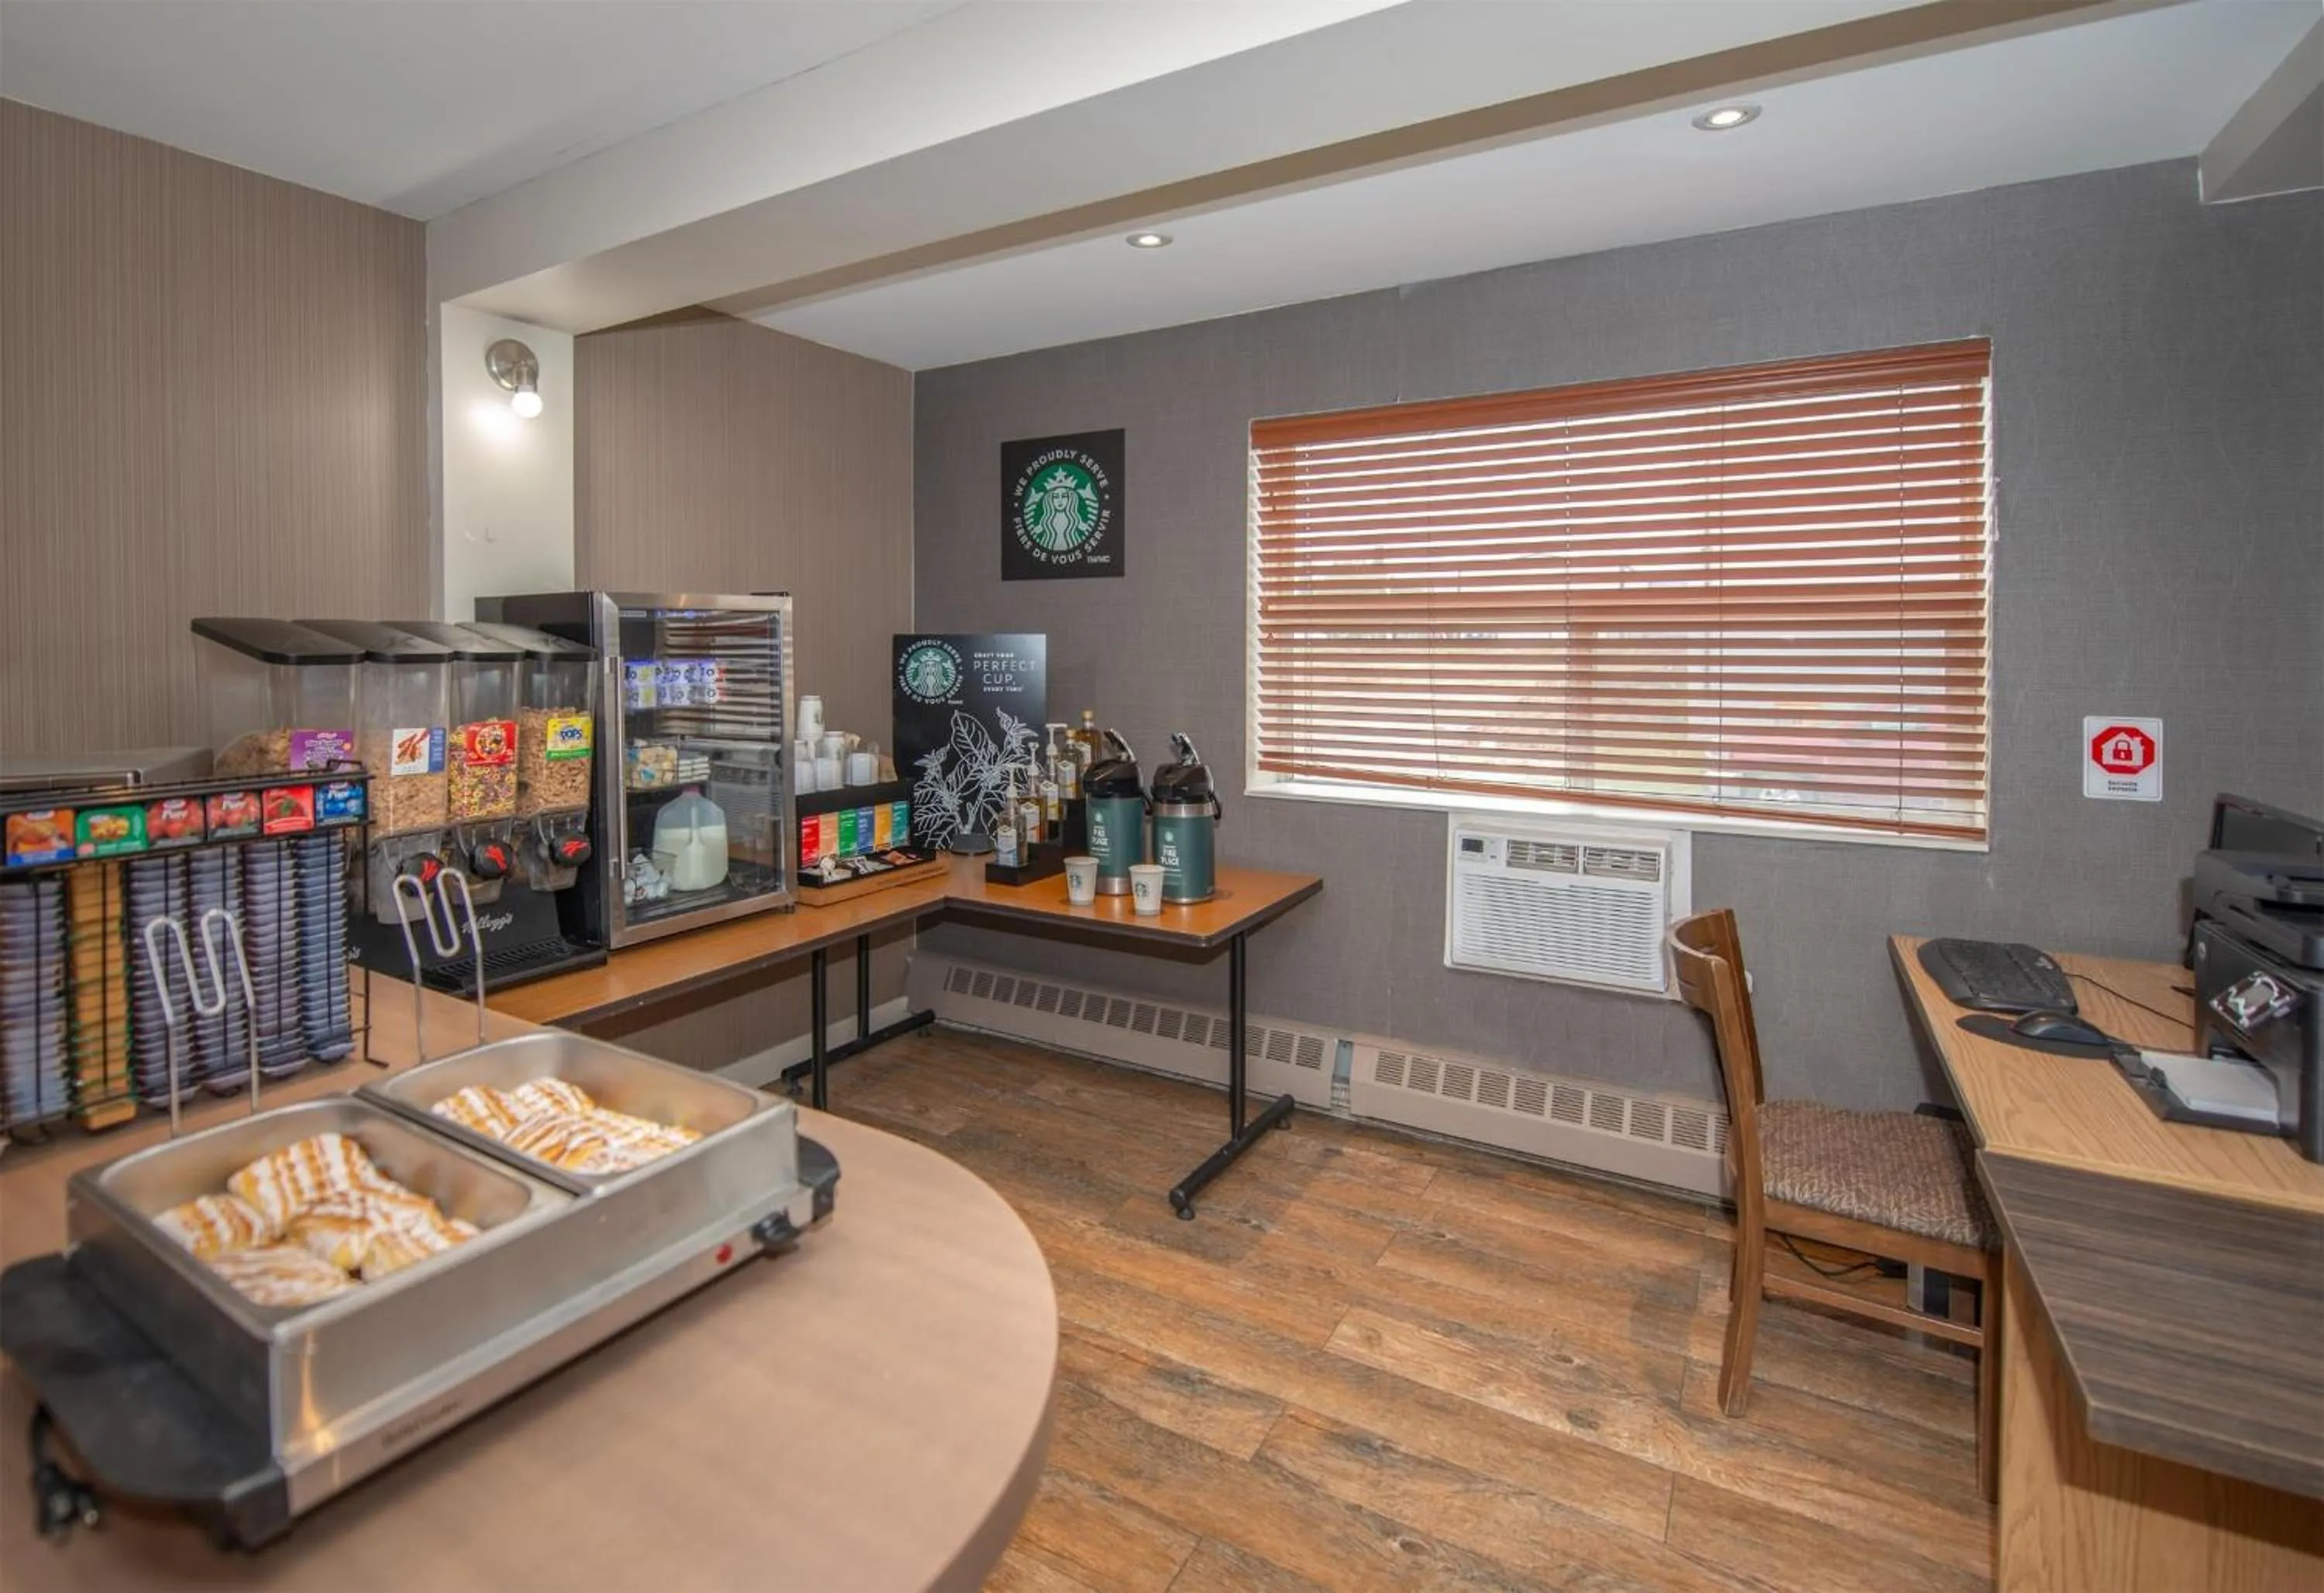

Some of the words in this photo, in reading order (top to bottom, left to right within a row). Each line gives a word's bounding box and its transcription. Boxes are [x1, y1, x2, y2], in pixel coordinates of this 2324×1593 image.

[1013, 477, 1028, 497] WE
[1026, 449, 1078, 476] PROUDLY
[1080, 454, 1109, 488] SERVE
[1033, 547, 1047, 562] DE
[1051, 549, 1082, 564] VOUS
[1084, 509, 1111, 552] SERVIR
[973, 659, 1036, 672] PERFECT
